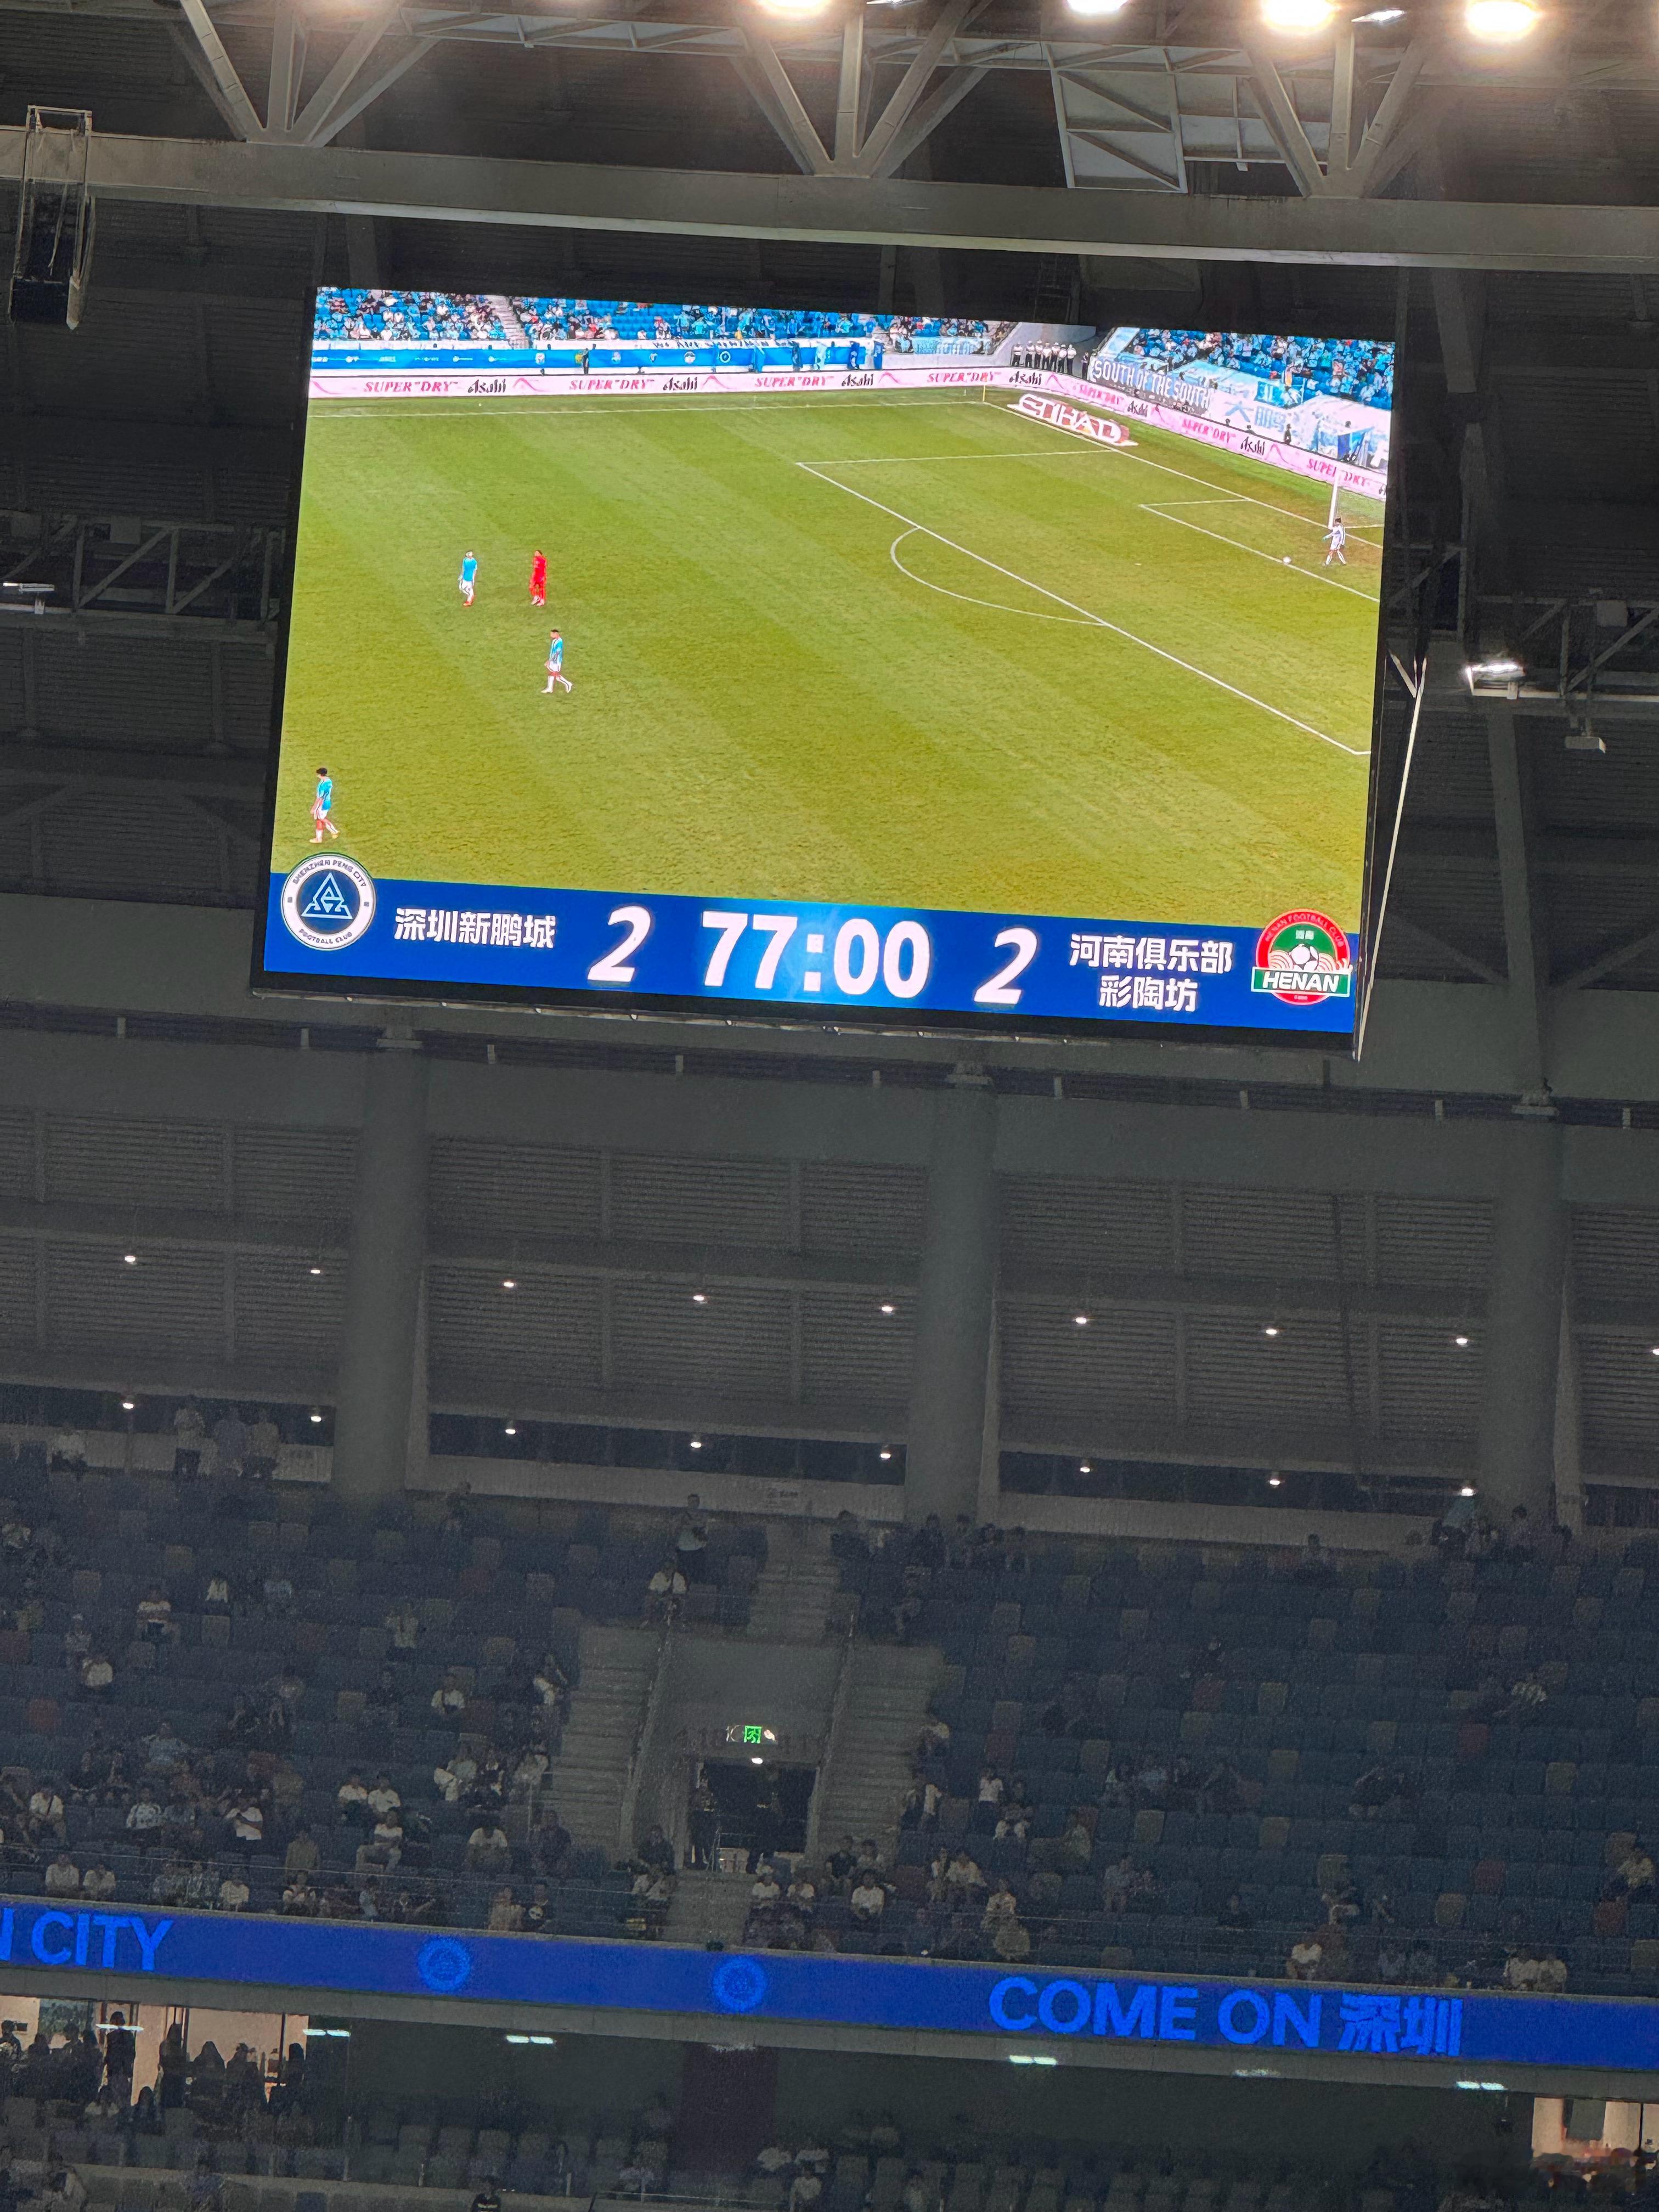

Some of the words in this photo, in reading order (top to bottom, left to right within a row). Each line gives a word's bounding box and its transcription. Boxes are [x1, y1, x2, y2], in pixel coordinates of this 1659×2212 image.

[364, 381, 411, 392] SUPER
[1094, 359, 1136, 387] SOUTH
[1136, 368, 1151, 390] OF
[1151, 372, 1172, 396] THE
[1172, 381, 1211, 409] SOUTH
[394, 908, 557, 949] 深圳新鹏城
[587, 905, 652, 983] 2
[1069, 933, 1234, 974] 河南俱乐部
[702, 911, 930, 998] 77:00
[974, 927, 1038, 1005] 2
[1099, 975, 1198, 1012] 彩陶坊
[1262, 970, 1339, 992] HENAN
[31, 1911, 174, 1971] CITY
[988, 1976, 1198, 2040] COME
[1217, 1989, 1322, 2049] ON
[1338, 1992, 1464, 2056] 深圳
